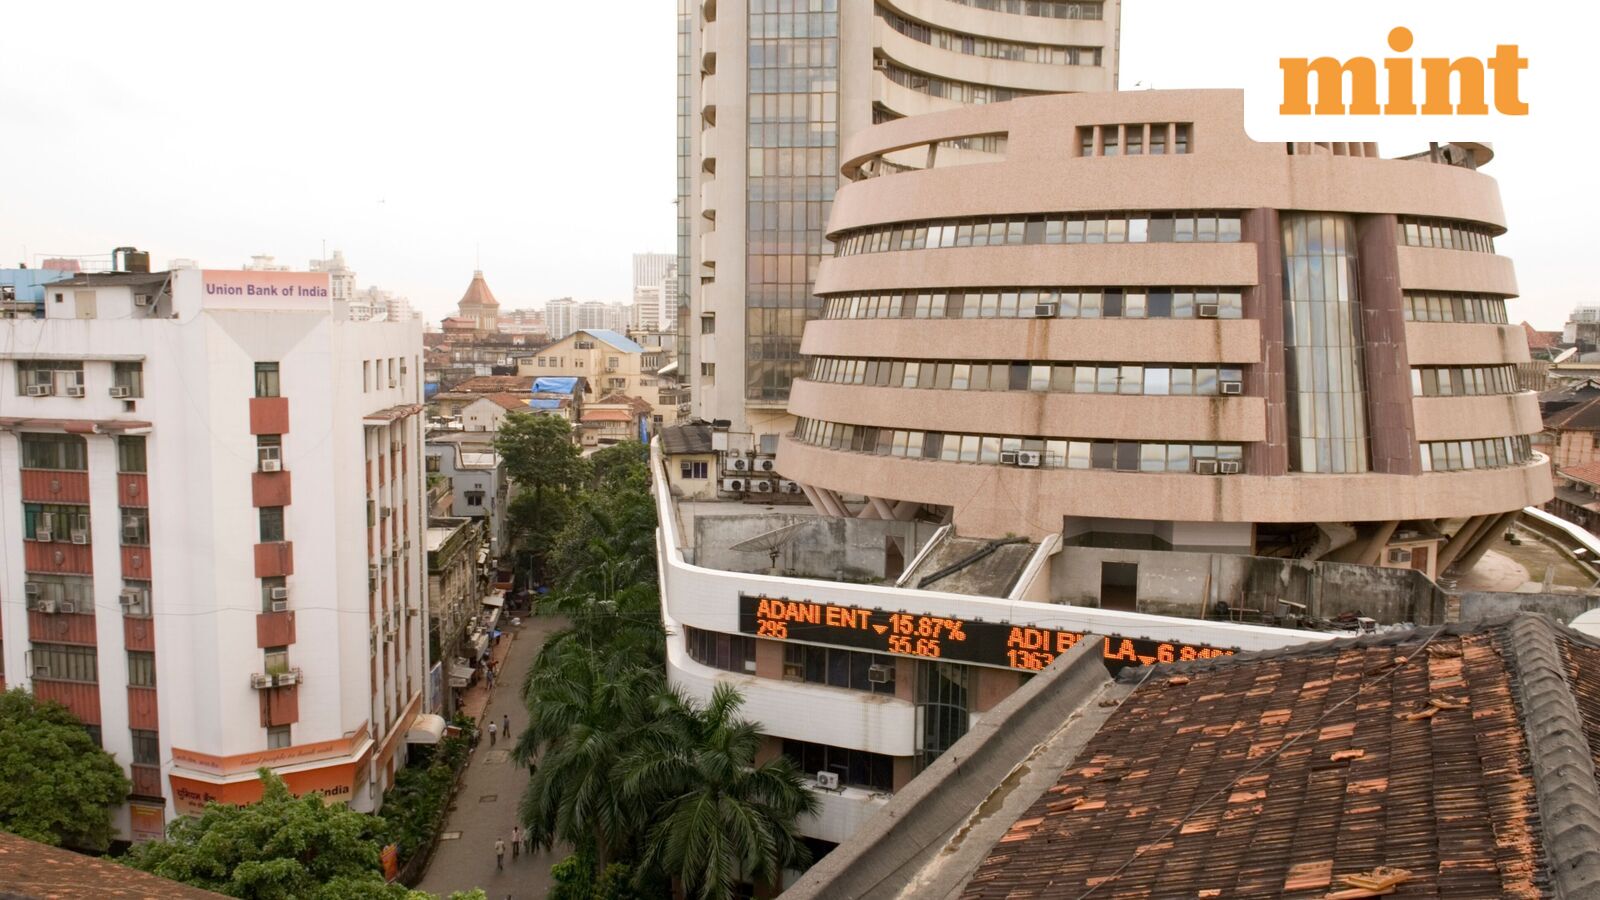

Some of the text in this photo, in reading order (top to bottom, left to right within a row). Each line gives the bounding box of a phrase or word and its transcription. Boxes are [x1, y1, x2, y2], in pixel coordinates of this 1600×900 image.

[206, 283, 328, 298] Union Bank of India
[756, 598, 967, 642] ADANI ENT 15.87%
[756, 618, 941, 658] 295 55.65
[1007, 626, 1050, 652] ADI
[1056, 631, 1137, 662] BLA
[321, 784, 350, 798] ndia
